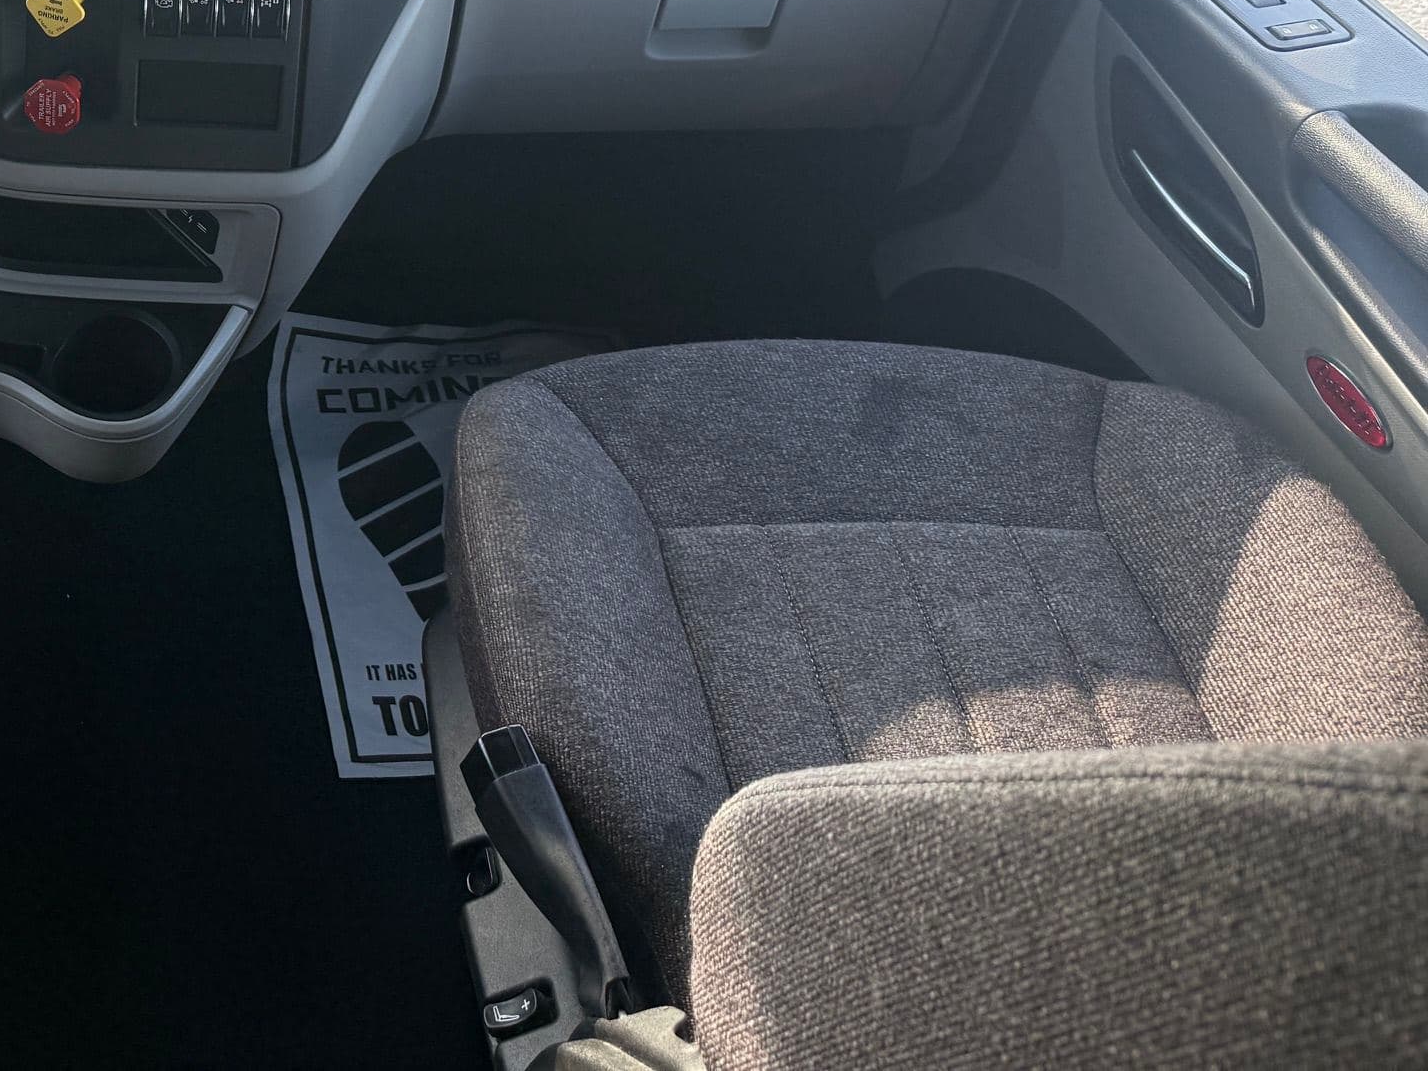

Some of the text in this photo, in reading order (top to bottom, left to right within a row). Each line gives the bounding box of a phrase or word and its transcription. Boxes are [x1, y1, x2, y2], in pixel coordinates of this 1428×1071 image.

[37, 10, 68, 23] PARKING
[321, 351, 503, 376] THANKS FOR
[316, 375, 510, 414] COMIN
[366, 665, 381, 681] IT
[385, 663, 417, 681] HAS
[372, 694, 429, 736] TO
